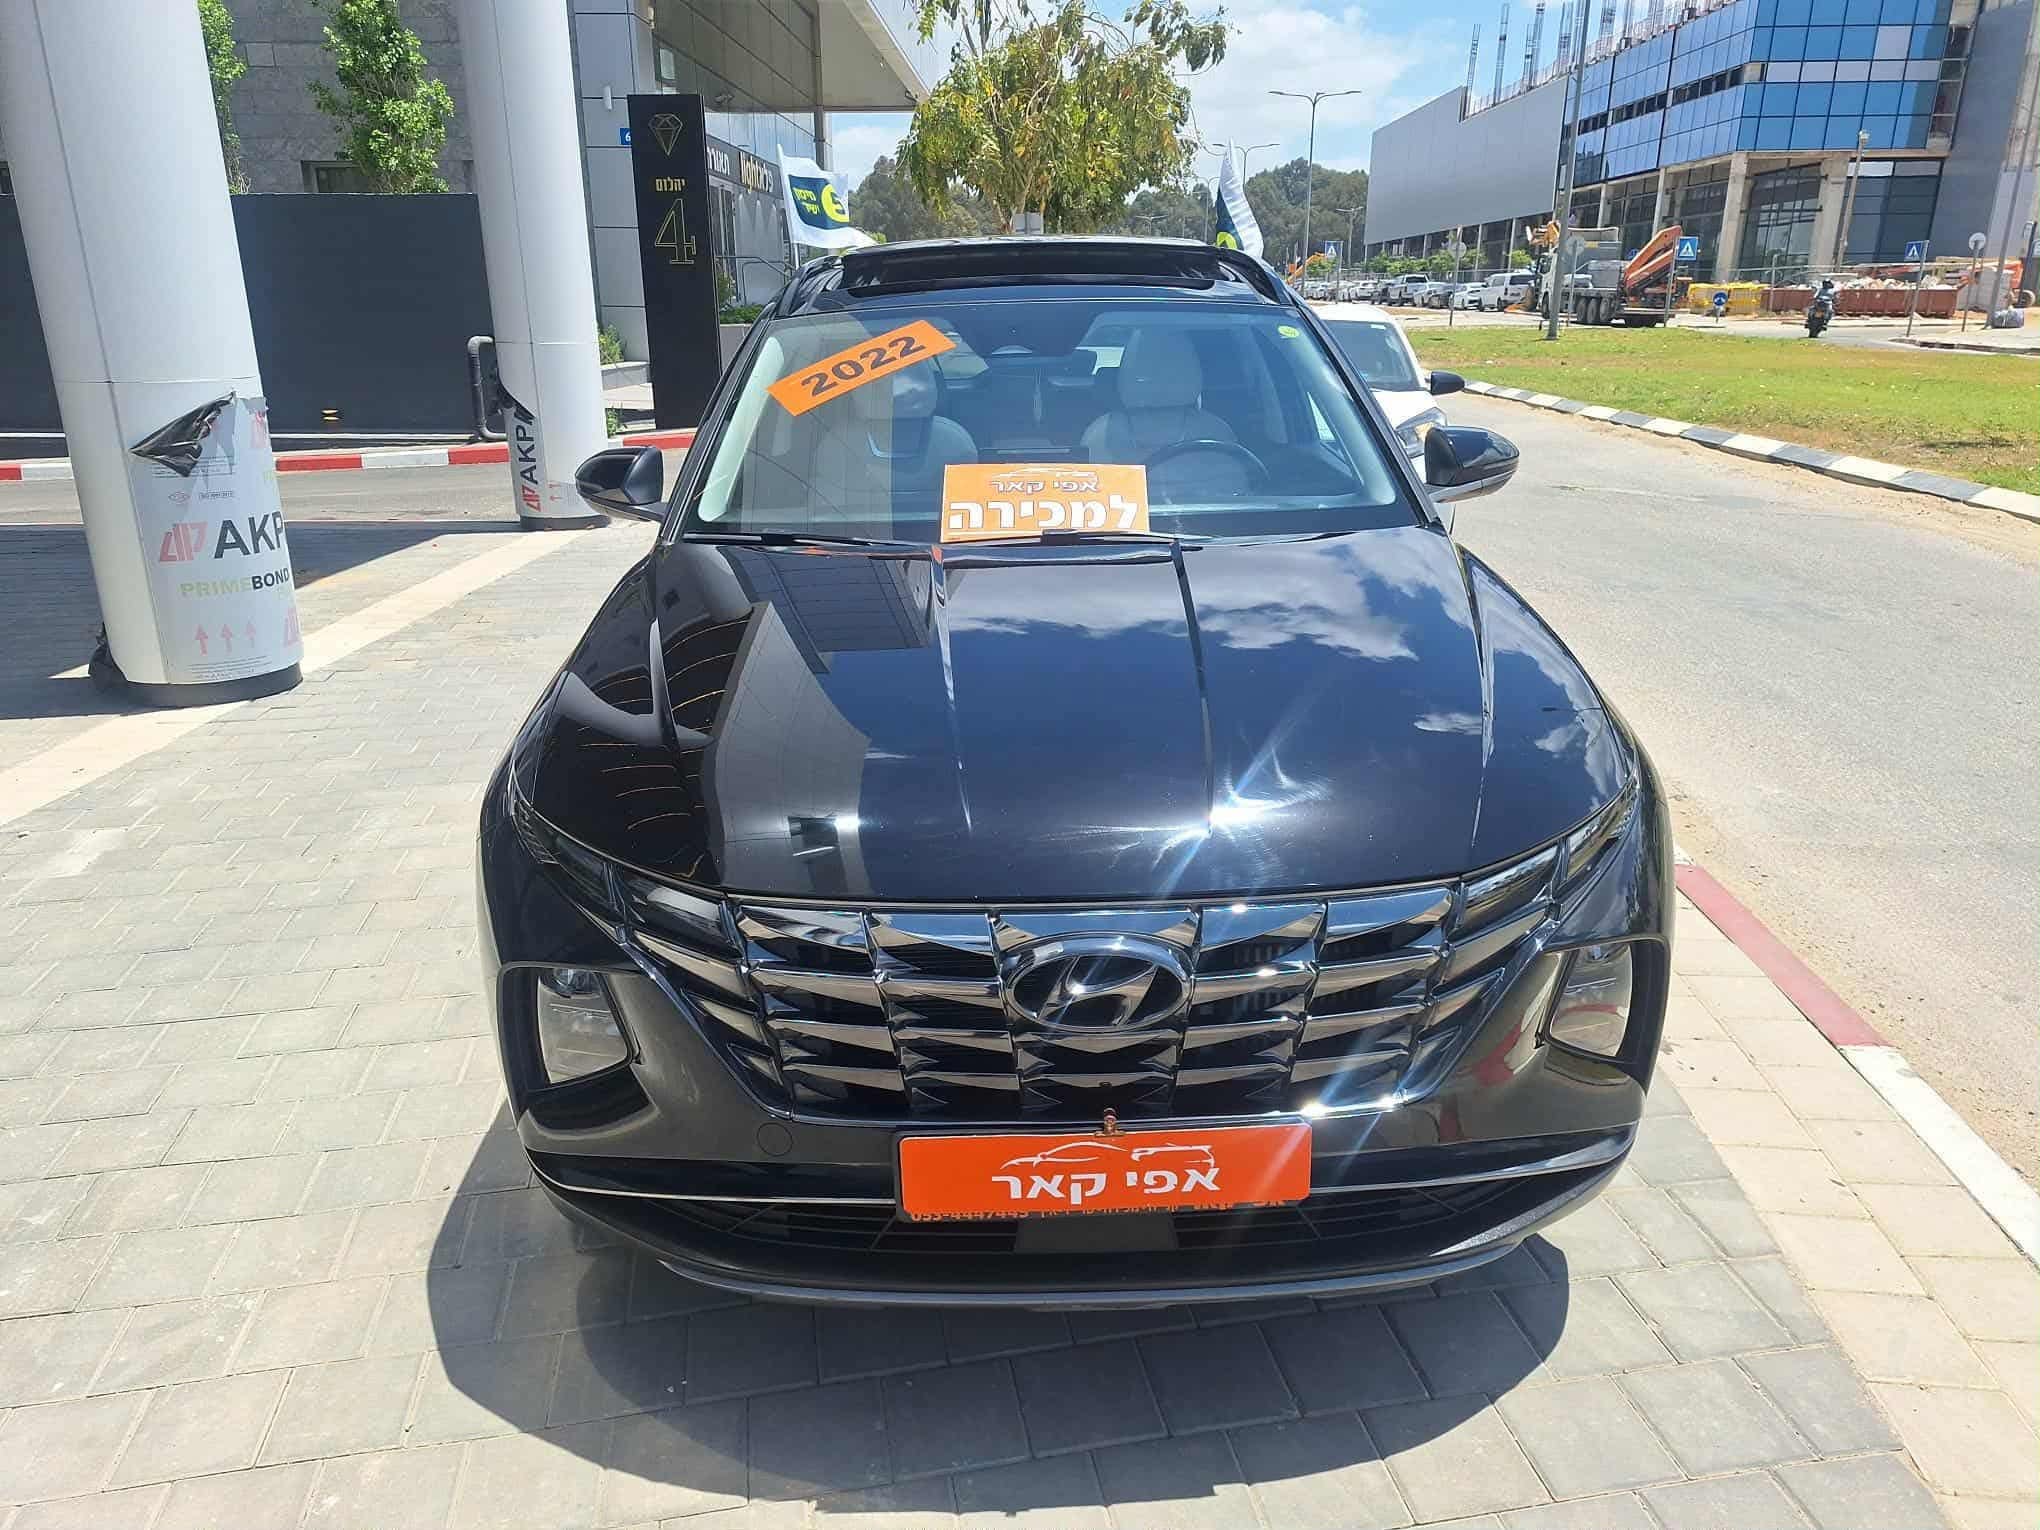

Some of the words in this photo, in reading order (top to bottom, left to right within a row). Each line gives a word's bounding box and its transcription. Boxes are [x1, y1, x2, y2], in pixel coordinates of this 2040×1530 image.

[655, 176, 687, 192] יהלום
[654, 197, 697, 264] 4
[800, 335, 926, 397] 2022
[990, 479, 1045, 495] קאר
[1052, 479, 1100, 494] אפי
[948, 494, 1138, 530] למכירה
[991, 1174, 1106, 1205] קאר
[1125, 1167, 1221, 1194] אפי
